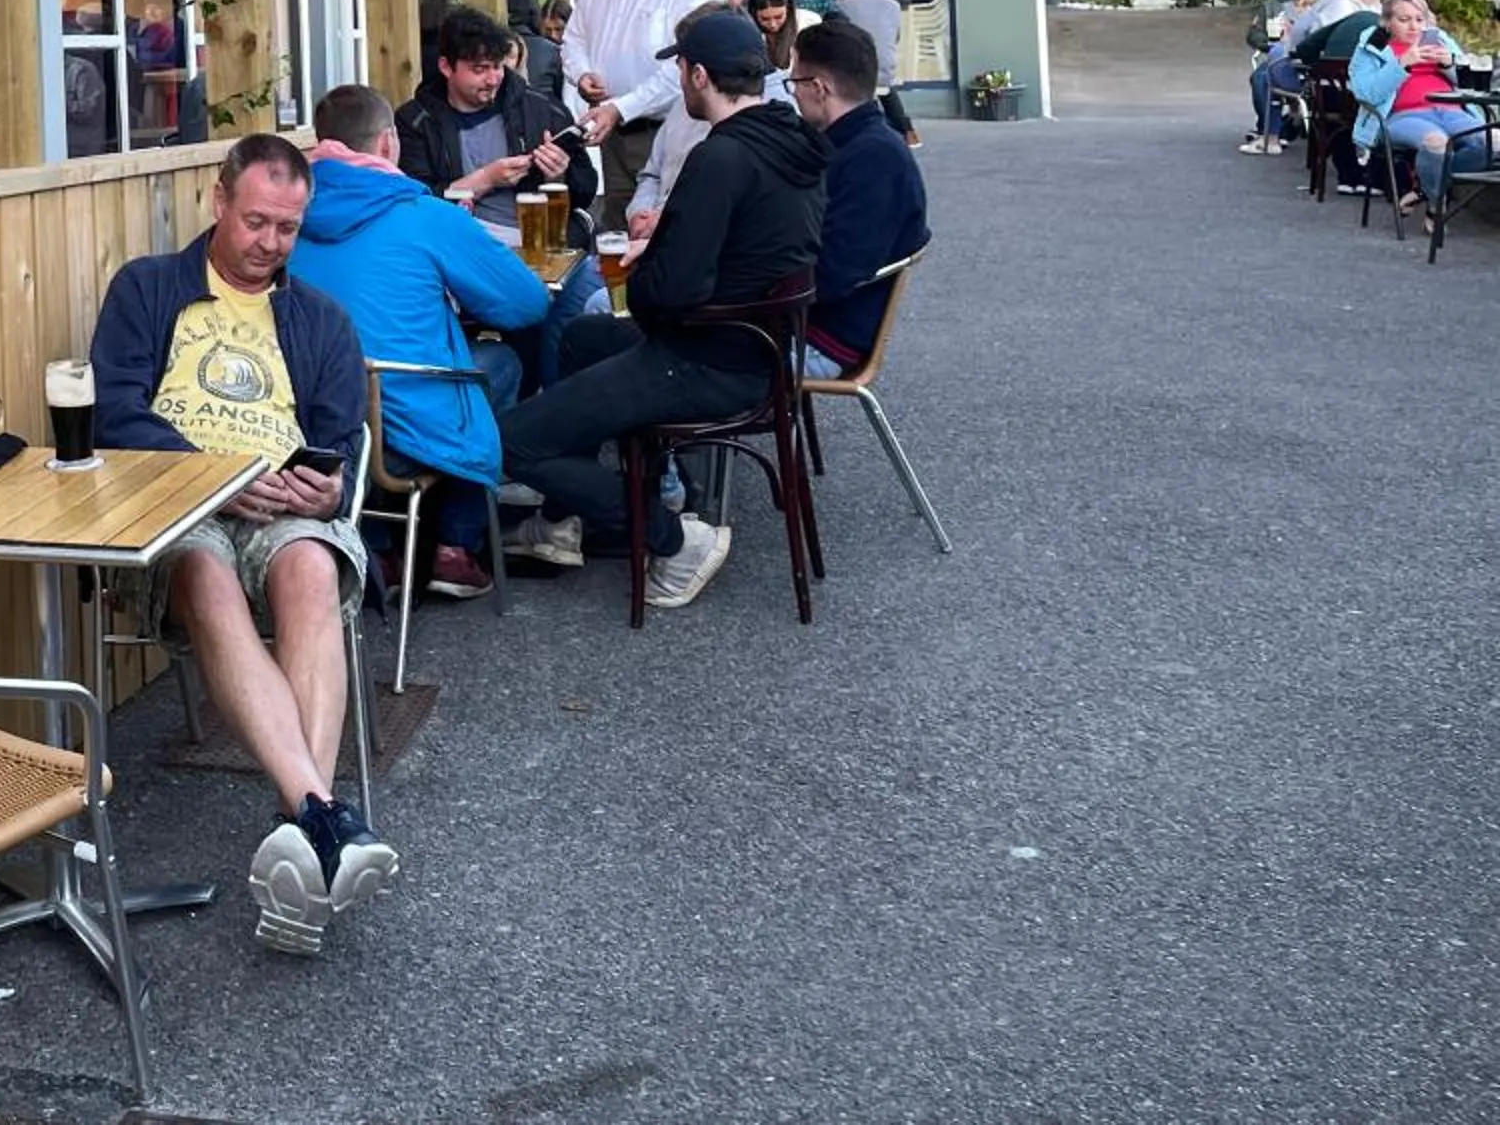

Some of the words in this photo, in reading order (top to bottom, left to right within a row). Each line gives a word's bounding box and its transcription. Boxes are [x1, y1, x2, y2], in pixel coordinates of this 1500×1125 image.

[158, 399, 187, 413] OS
[196, 402, 297, 442] ANGELE
[170, 418, 220, 429] ALITY
[227, 422, 269, 439] SURF
